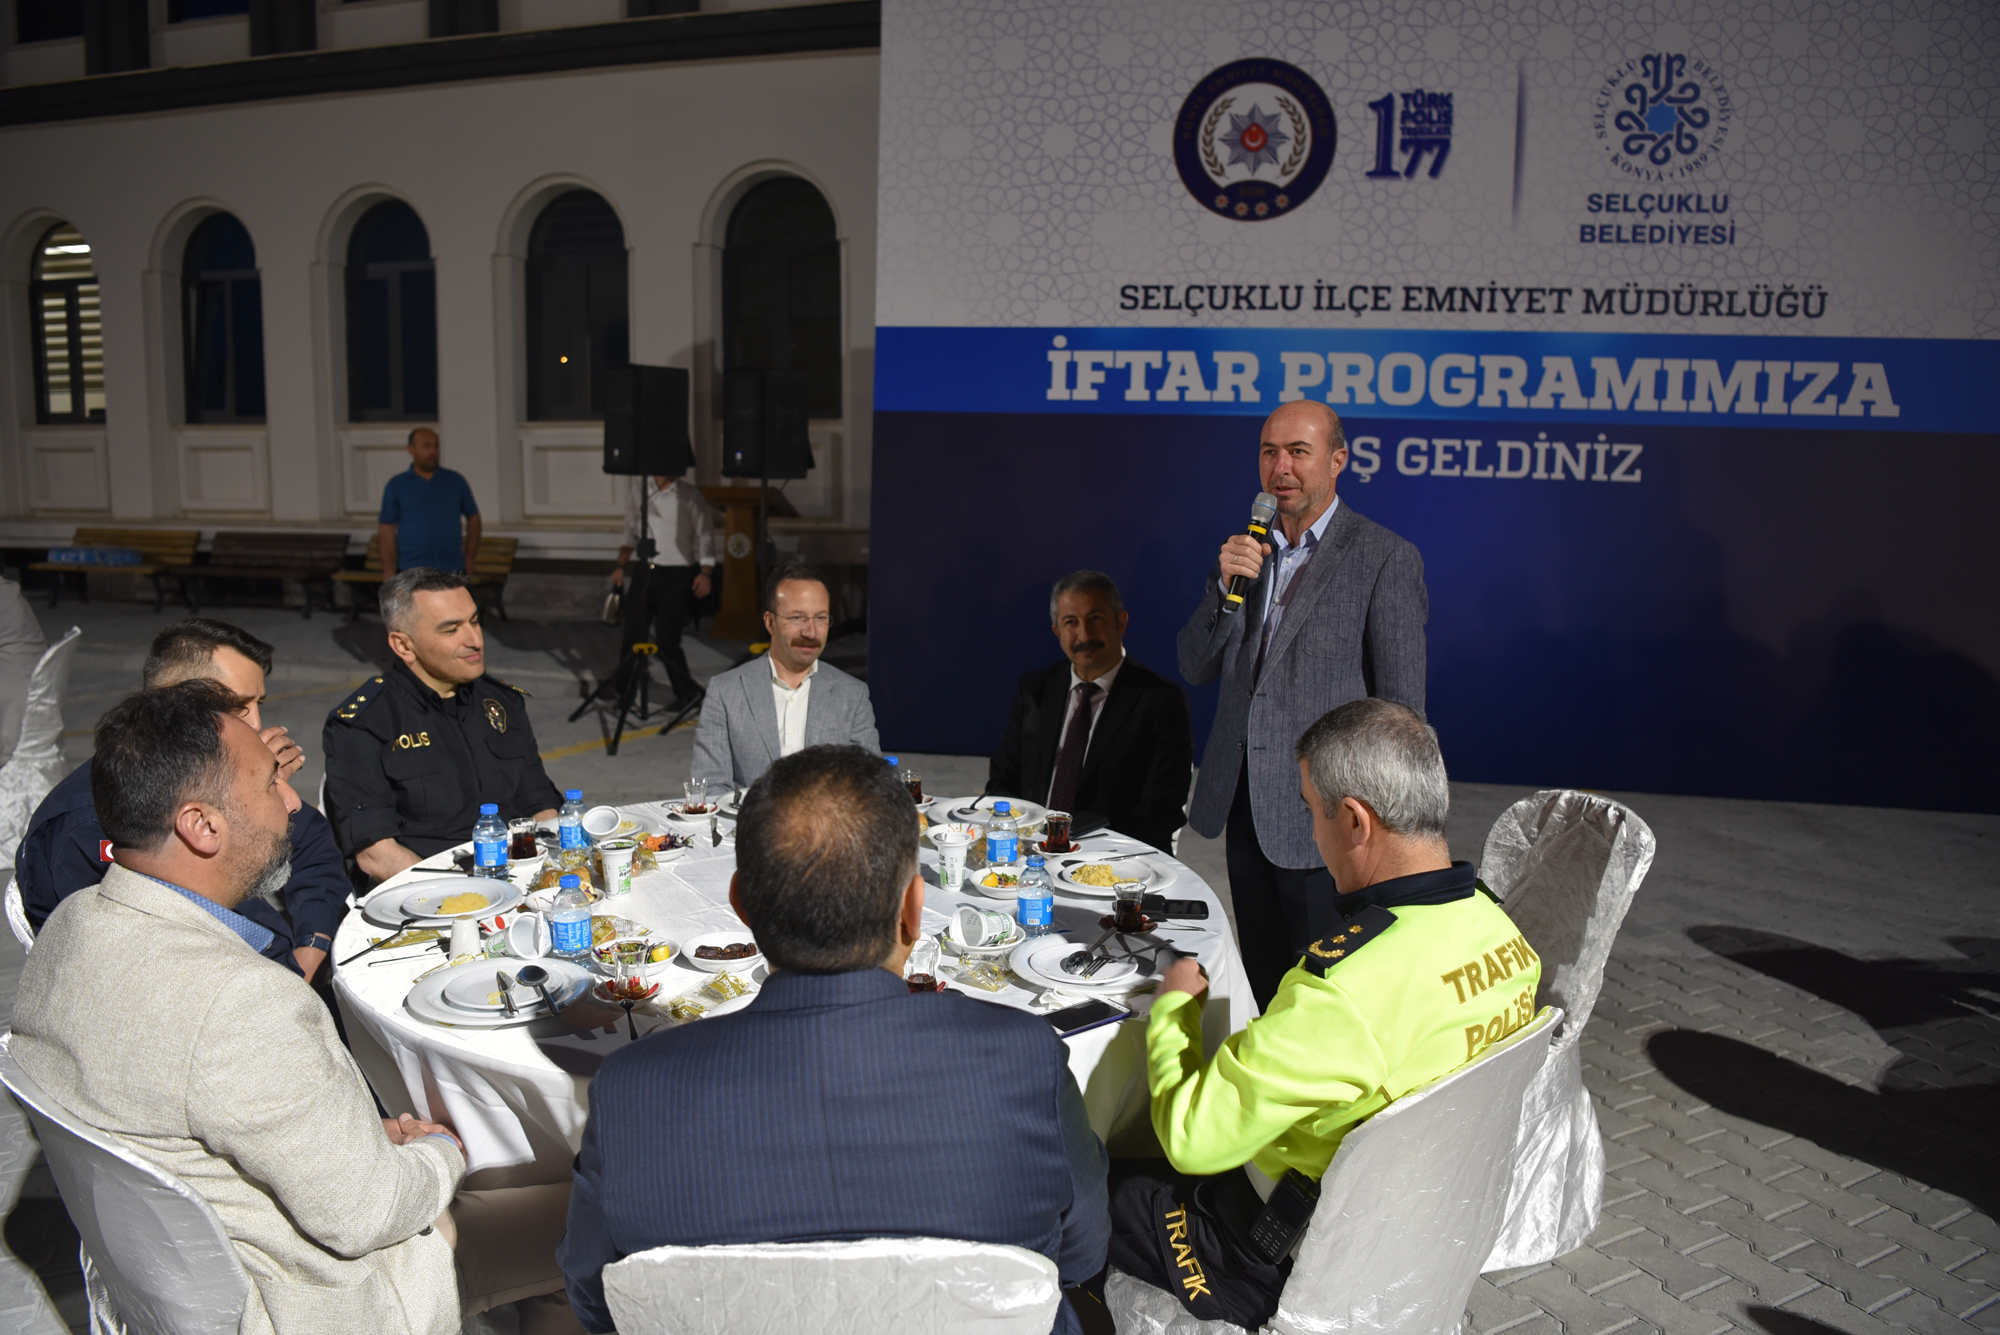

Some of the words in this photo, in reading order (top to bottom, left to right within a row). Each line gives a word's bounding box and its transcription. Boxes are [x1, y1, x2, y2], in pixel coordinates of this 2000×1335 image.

[1594, 59, 1638, 140] SELÇUKLU
[1611, 152, 1665, 182] KONYA
[1679, 152, 1709, 178] 1989
[1579, 219, 1736, 245] BELEDİYESİ
[1587, 193, 1729, 219] SELÇUKLU
[1119, 284, 1305, 317] SELÇUKLU
[1313, 278, 1393, 317] İLÇE
[1401, 280, 1573, 314] EMNİYET
[1582, 282, 1830, 319] MÜDÜRLÜĞÜ
[1046, 334, 1261, 403] İFTAR
[1278, 350, 1901, 418] PROGRAMIMIZA
[1395, 431, 1644, 483] GELDİNİZ
[1440, 934, 1539, 1005] TRAFİK
[1464, 984, 1536, 1061] POLİSİ
[1164, 1202, 1212, 1302] TRAFİK
